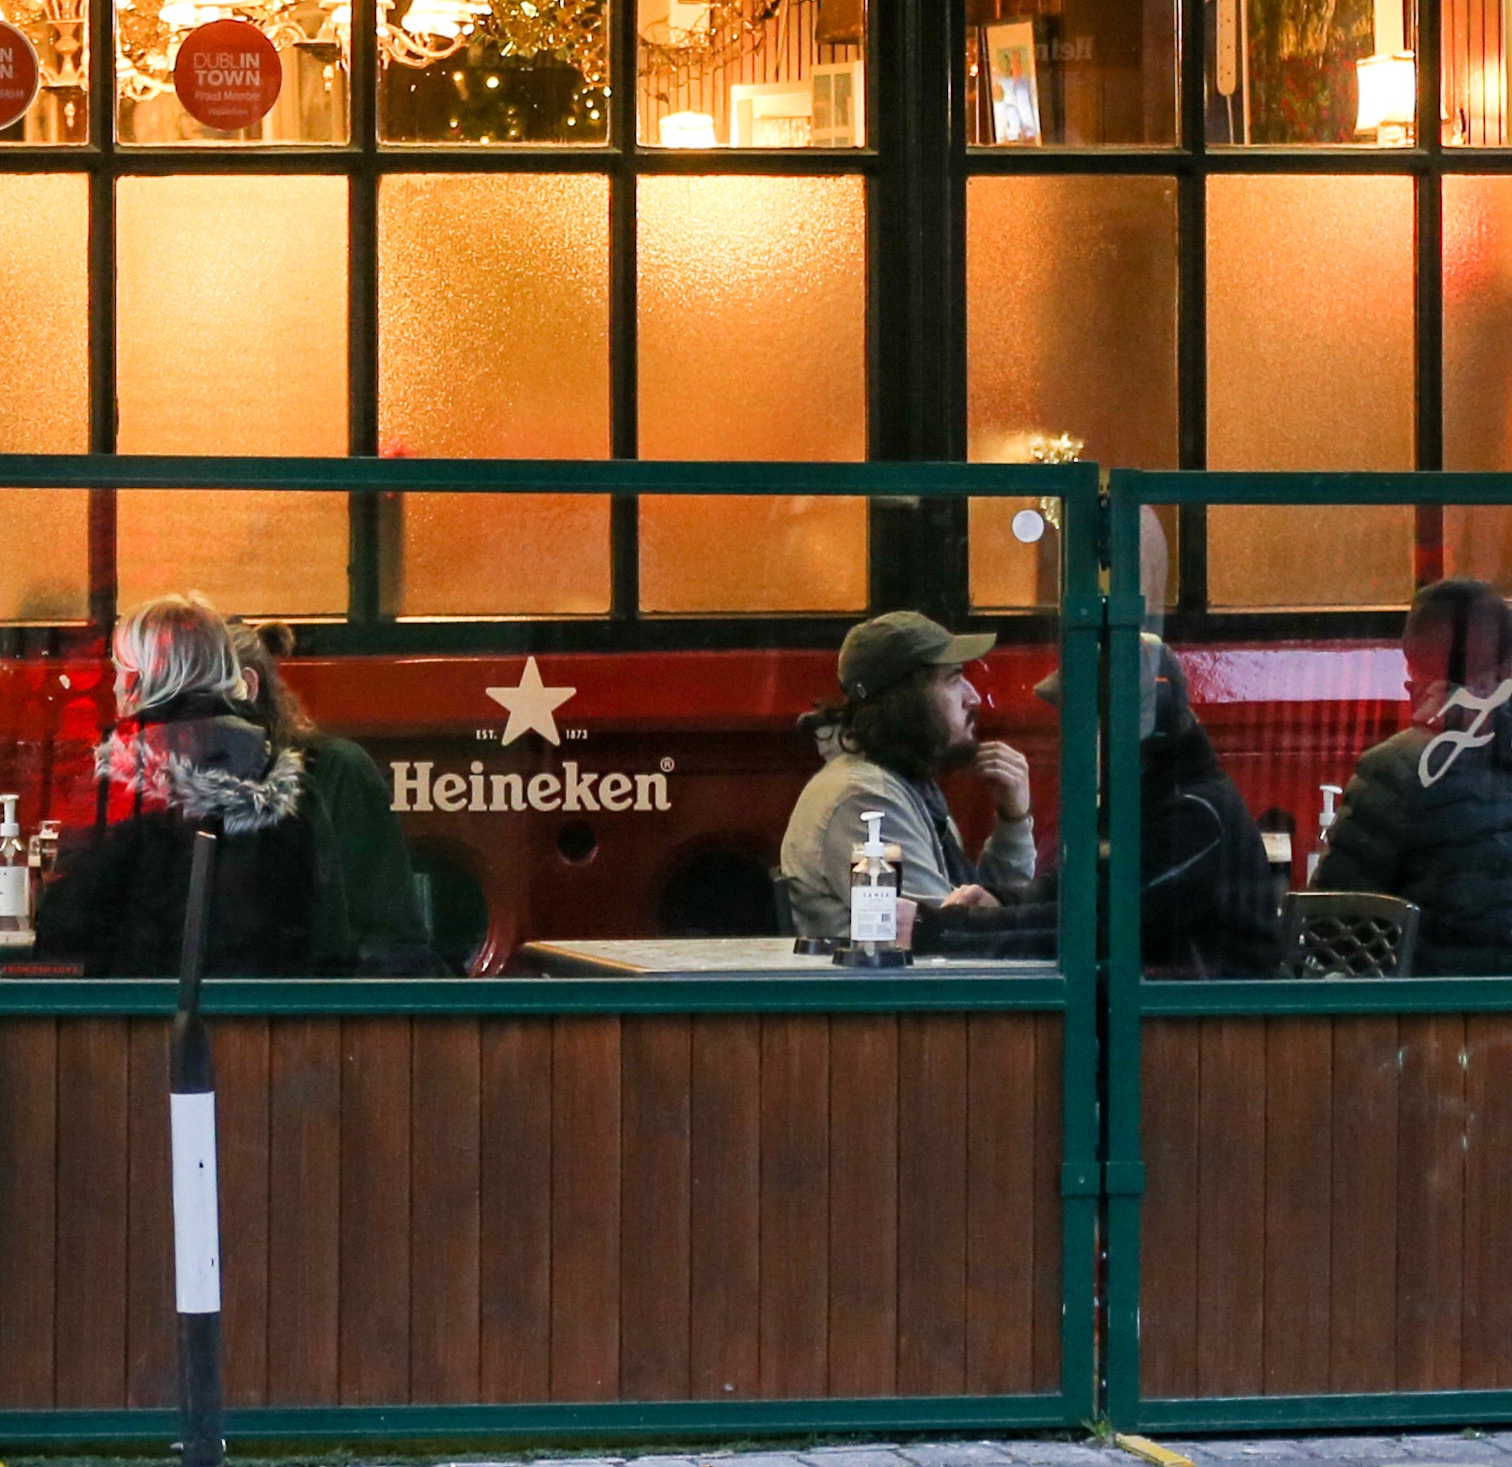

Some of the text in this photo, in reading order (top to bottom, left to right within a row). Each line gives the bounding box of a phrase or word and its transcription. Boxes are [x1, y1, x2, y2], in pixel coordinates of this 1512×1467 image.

[193, 52, 260, 69] DUBLIN
[194, 70, 261, 86] TOWN
[475, 728, 589, 740] EST. 1873
